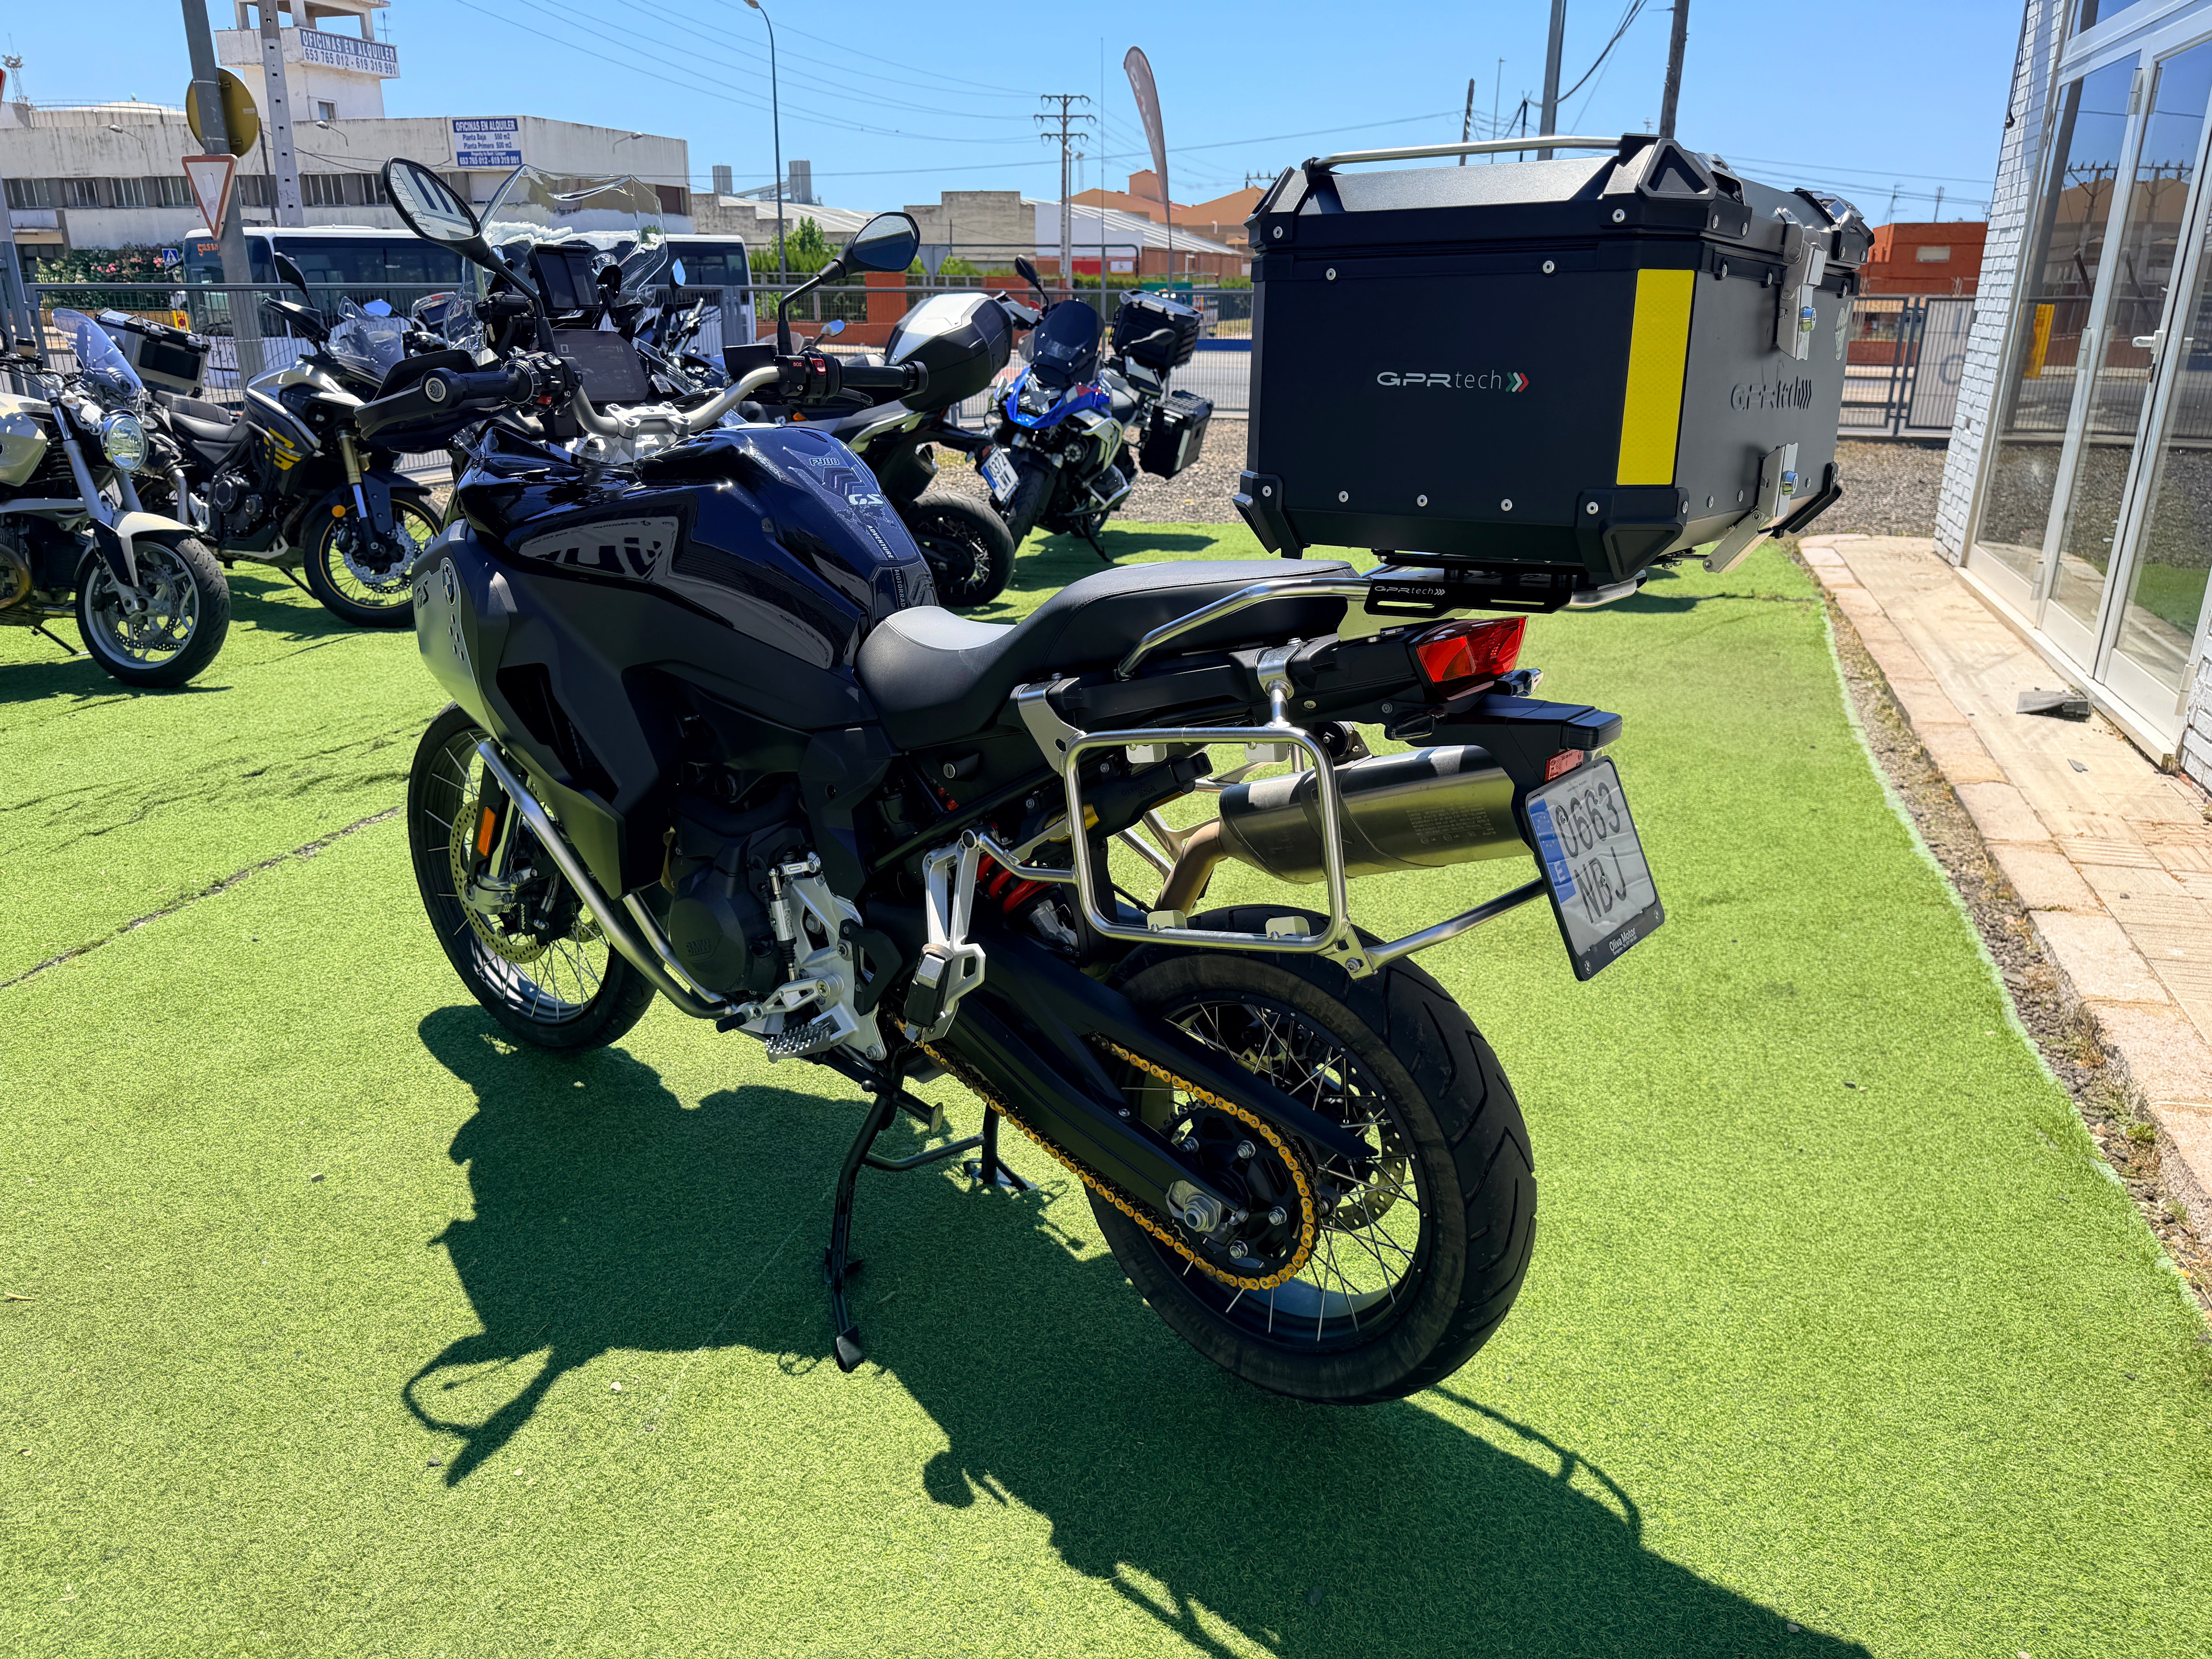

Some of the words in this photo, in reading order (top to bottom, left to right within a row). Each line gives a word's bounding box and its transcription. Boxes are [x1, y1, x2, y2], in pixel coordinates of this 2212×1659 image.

[302, 31, 342, 52] OFICINAS
[344, 39, 355, 54] EN
[358, 41, 395, 61] ALQUILER
[305, 48, 318, 61] 653
[321, 51, 334, 64] 765
[336, 54, 349, 66] 012
[356, 57, 368, 70] 619
[370, 60, 382, 72] 319
[385, 62, 396, 74] 991
[455, 121, 480, 131] OFICINAS
[481, 121, 488, 131] EN
[489, 120, 515, 131] ALQUILER
[1377, 369, 1501, 389] GPRtech
[809, 457, 840, 466] F900
[988, 452, 1006, 478] 0372
[848, 494, 884, 505] GS
[867, 524, 895, 559] ADVENTURE
[894, 569, 905, 607] MOTORRAD
[1374, 585, 1433, 596] GPRtech
[1555, 782, 1620, 859] 0663
[1554, 860, 1566, 883] E
[1574, 847, 1627, 924] NBJ
[1609, 938, 1623, 951] Oliva
[1621, 927, 1636, 943] Motor
